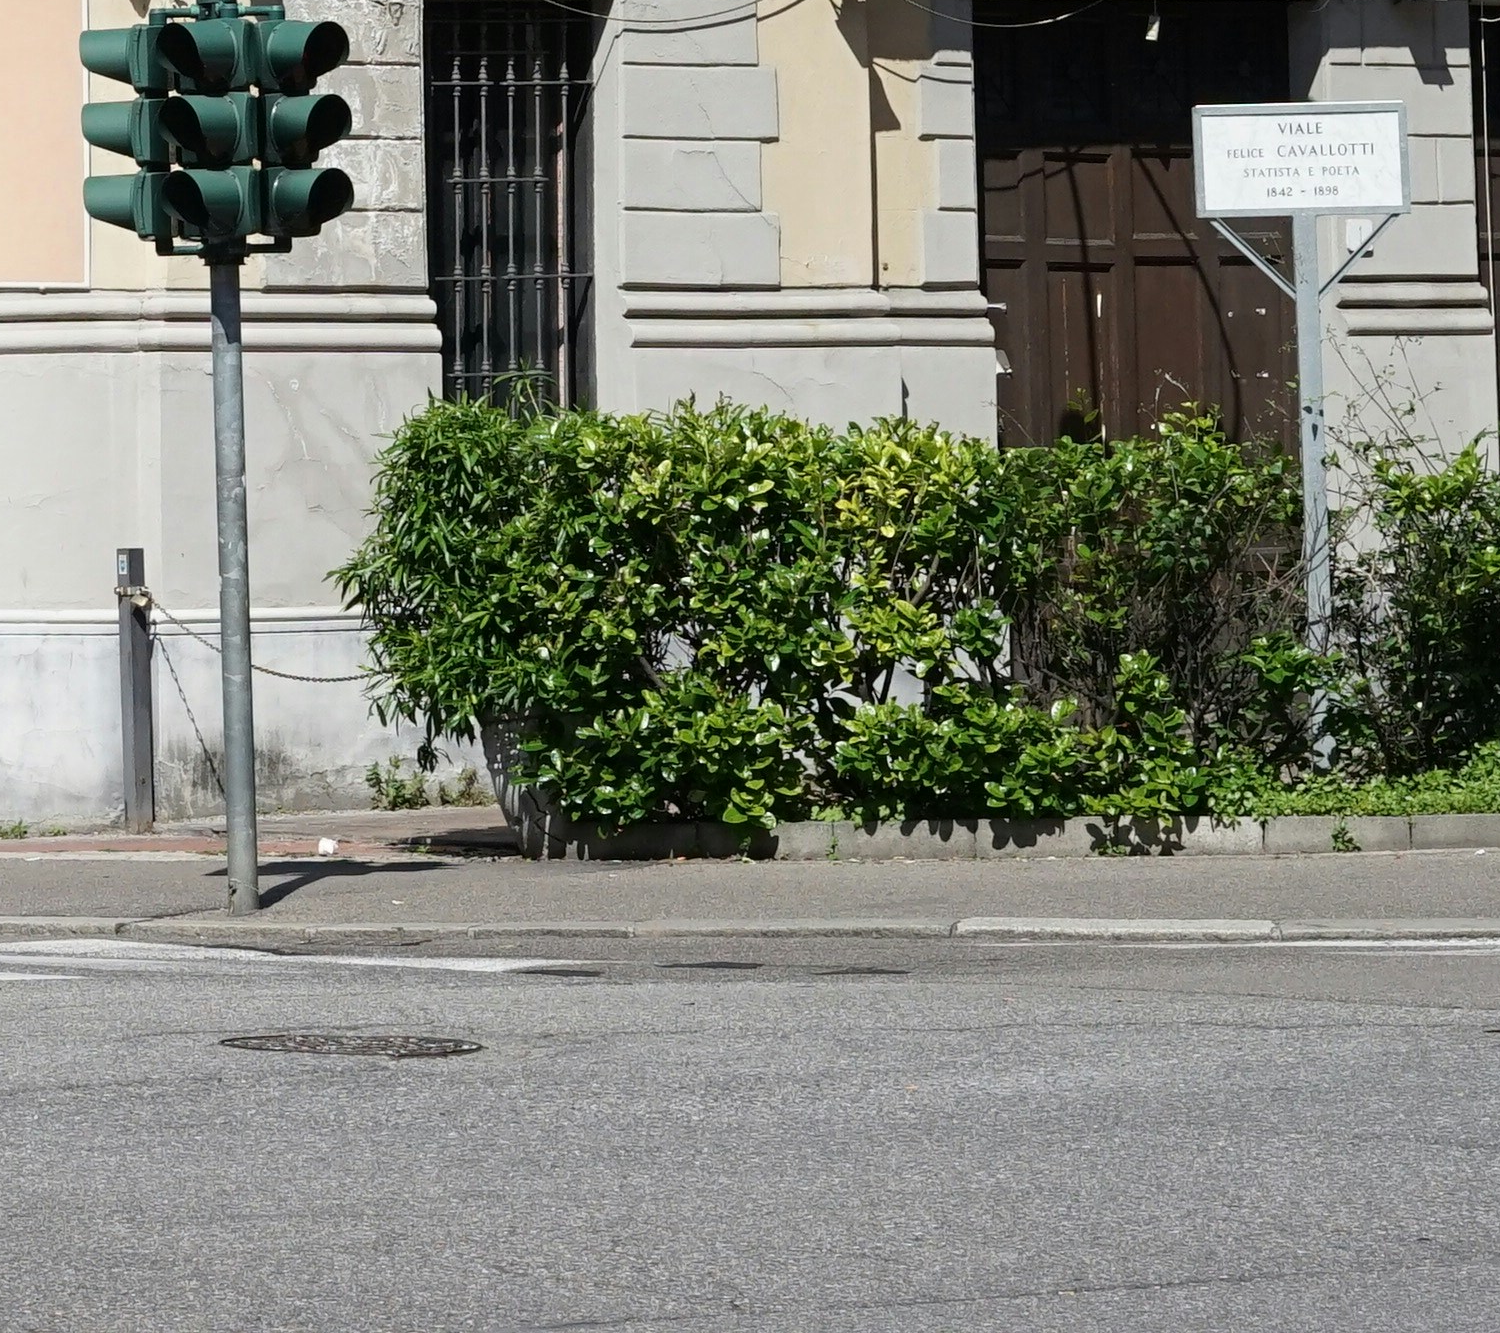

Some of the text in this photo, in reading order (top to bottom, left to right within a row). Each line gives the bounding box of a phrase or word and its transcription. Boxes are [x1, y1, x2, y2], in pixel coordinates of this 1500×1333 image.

[1277, 121, 1324, 135] VIALE
[1226, 142, 1375, 159] FELICE CAVALLOTTI
[1243, 165, 1360, 179] STATISTA E POETA
[1266, 186, 1293, 198] 1842
[1314, 185, 1339, 197] 1898
